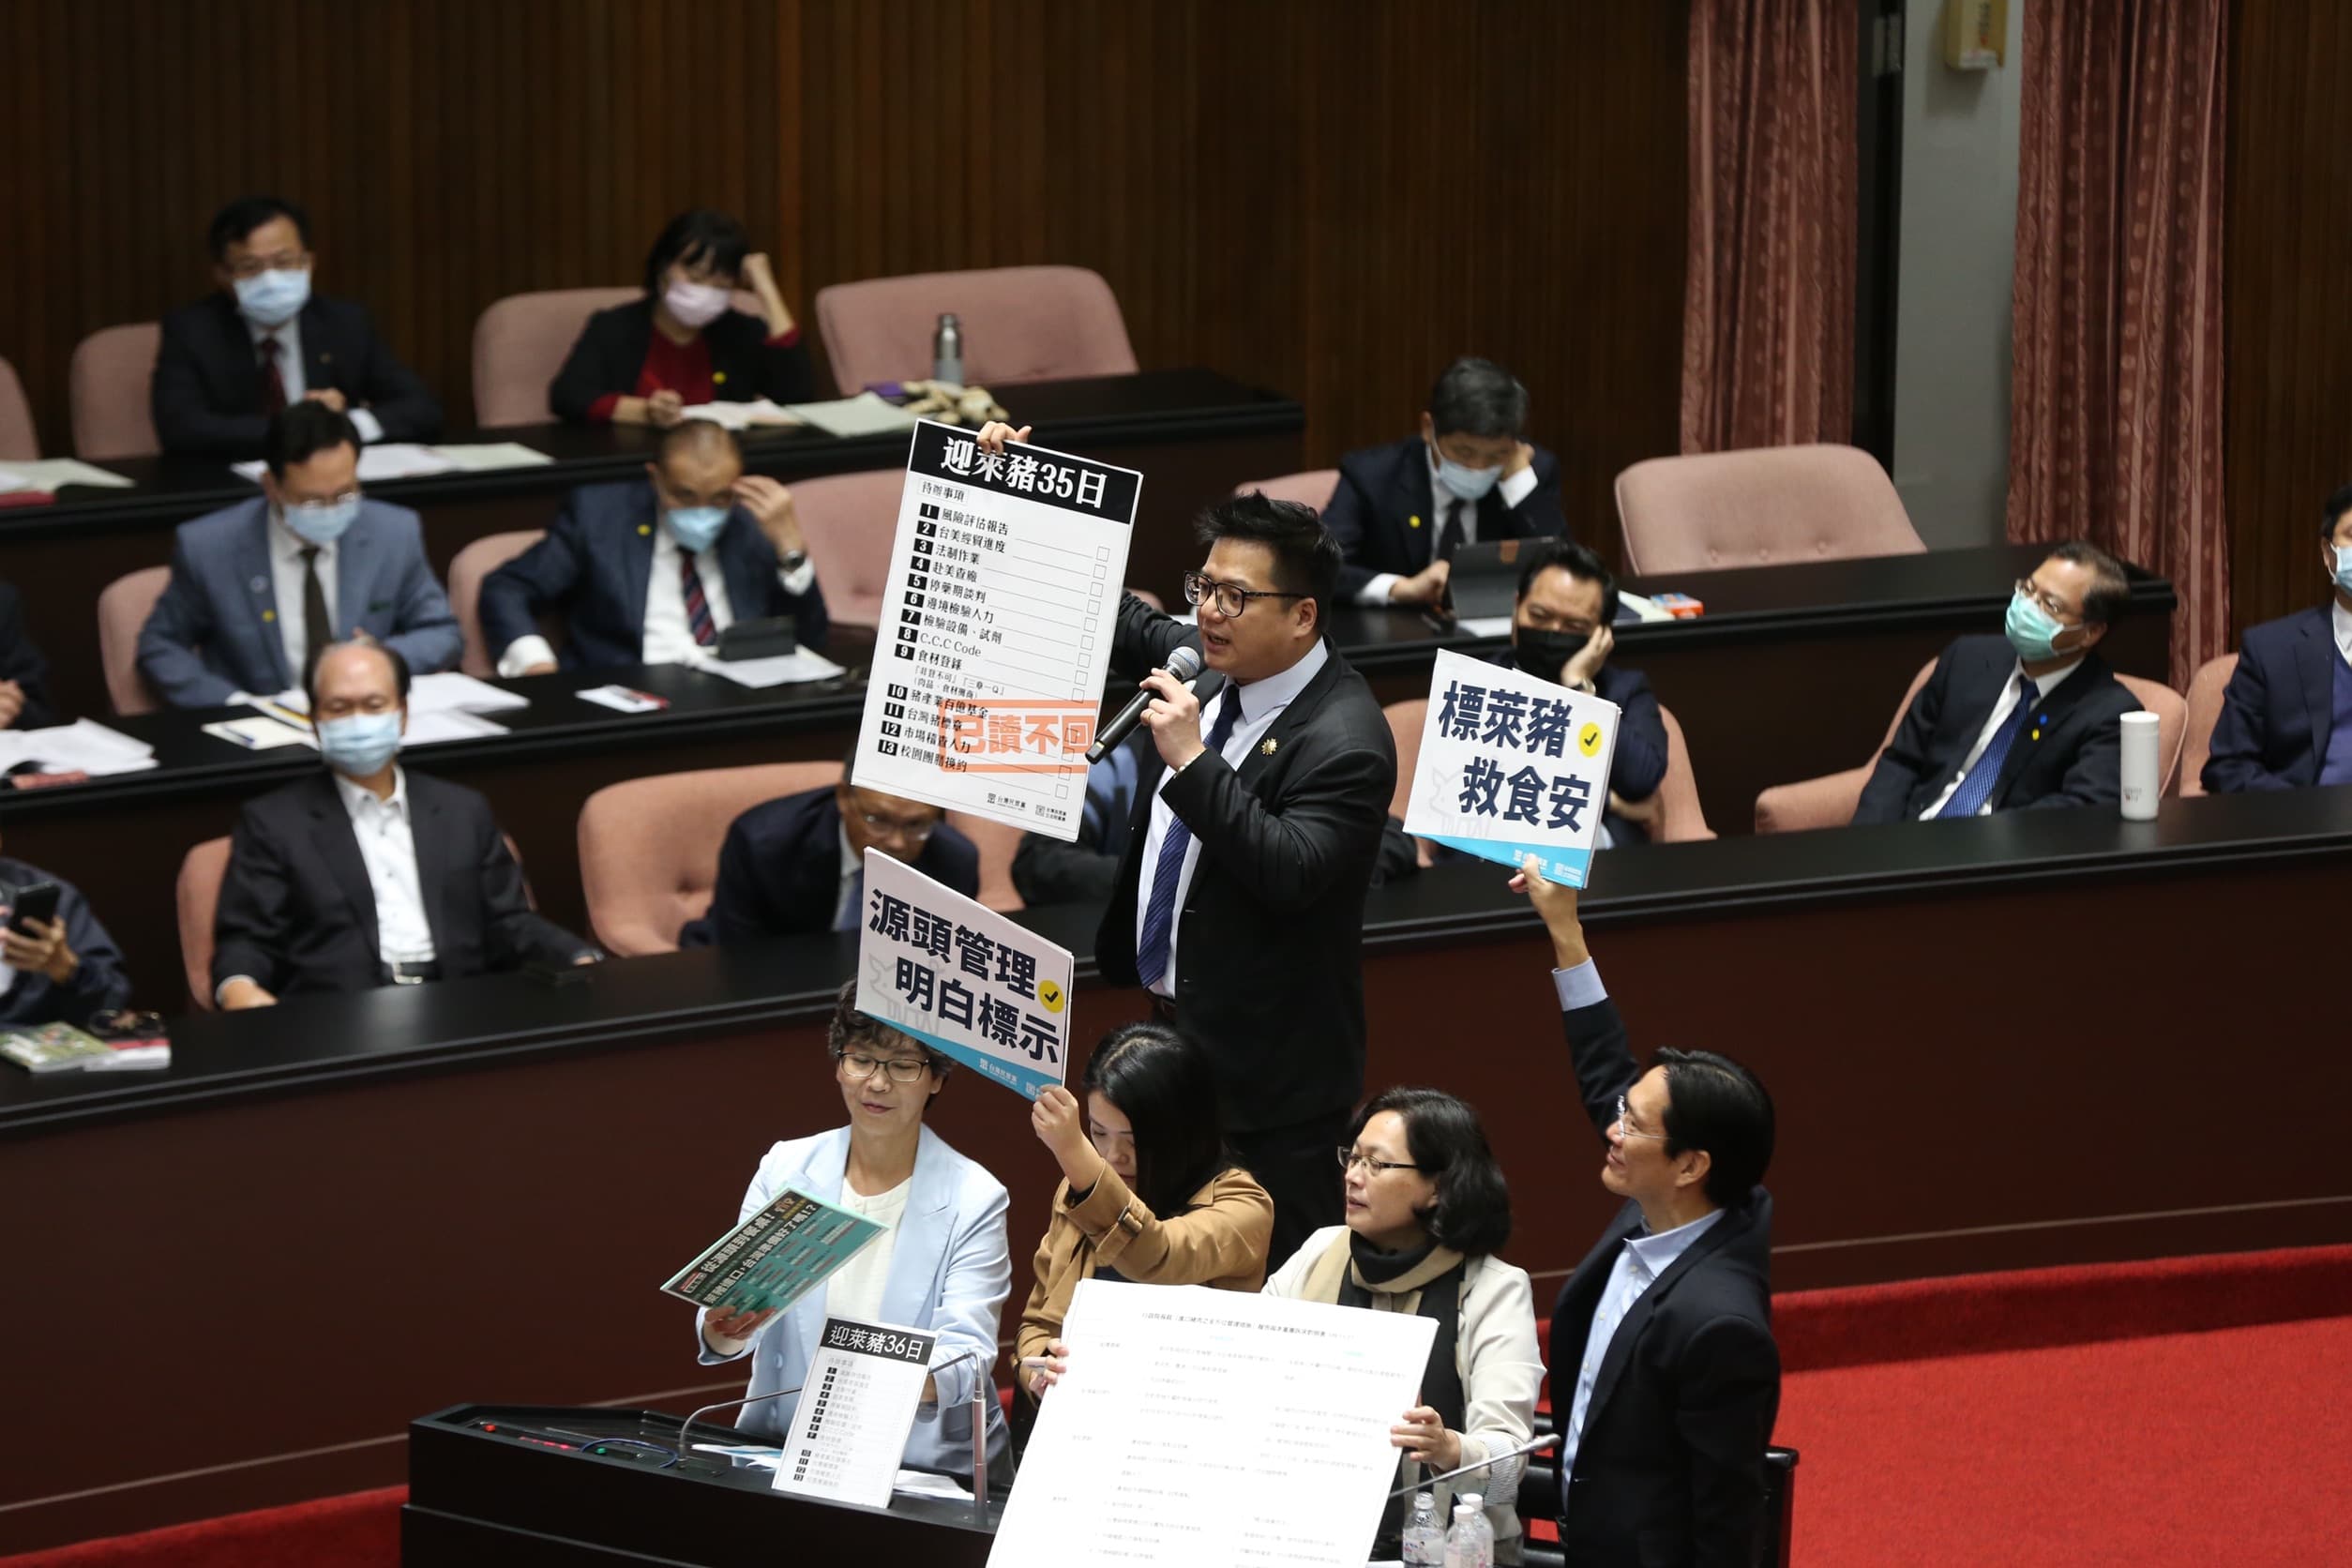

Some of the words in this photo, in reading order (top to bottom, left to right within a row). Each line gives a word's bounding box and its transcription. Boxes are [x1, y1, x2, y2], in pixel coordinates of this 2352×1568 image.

[942, 508, 1009, 535] 風險評估報告
[939, 526, 1006, 553] 台美經貿進度
[935, 544, 981, 565] 法制作業
[932, 562, 978, 582] 赴美查廠
[930, 579, 987, 604] 停藥期談判
[927, 596, 995, 624] 邊境檢驗人力
[920, 633, 952, 649] C.C.C
[954, 642, 982, 657] Code
[1439, 680, 1574, 758] 標萊豬
[952, 715, 1095, 754] 已讀不回
[1458, 756, 1591, 833] 救食安
[868, 888, 1036, 1001] 源頭管理
[896, 957, 1060, 1064] 明白標示
[828, 1325, 924, 1360] 迎萊豬36日
